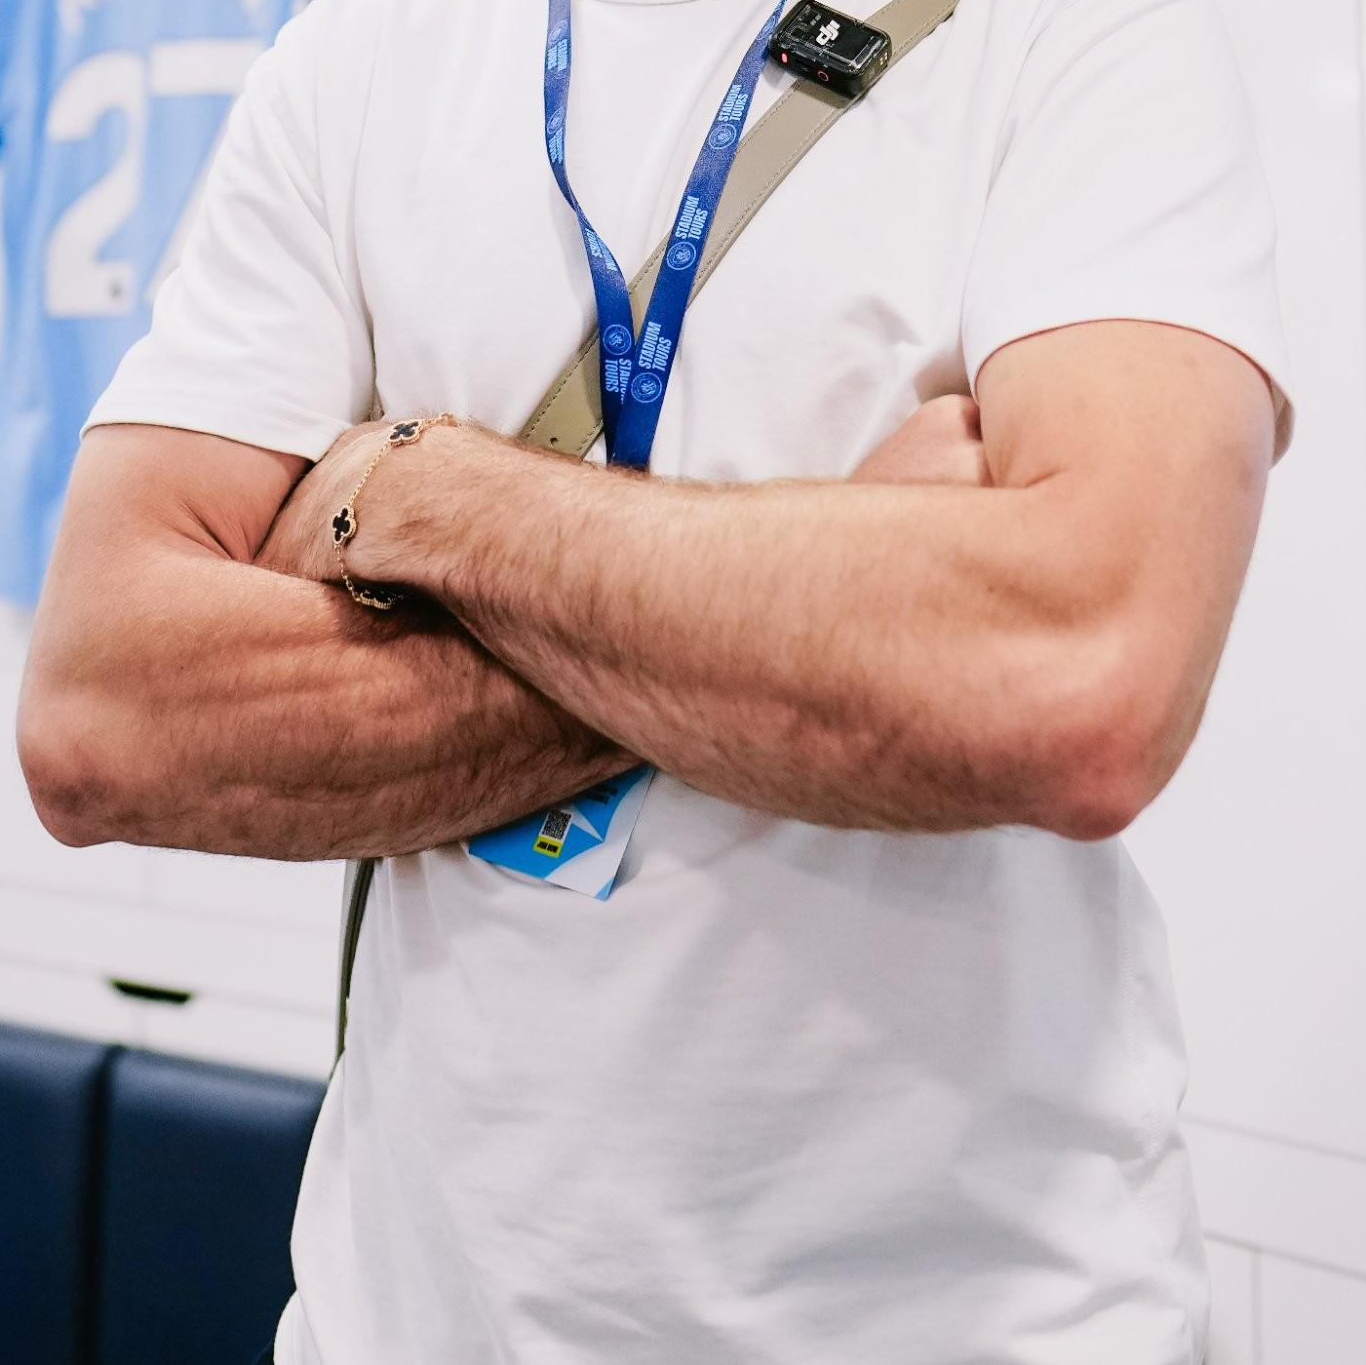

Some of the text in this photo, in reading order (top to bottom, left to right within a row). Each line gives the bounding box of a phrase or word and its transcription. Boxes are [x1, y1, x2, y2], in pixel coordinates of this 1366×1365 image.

[719, 83, 742, 123] STADIUM
[729, 93, 749, 122] TOURS
[675, 196, 700, 240] STADIUM
[687, 208, 709, 241] TOURS
[638, 321, 662, 370] STADIUM
[652, 337, 672, 372] TOURS
[604, 358, 620, 393] TOURS
